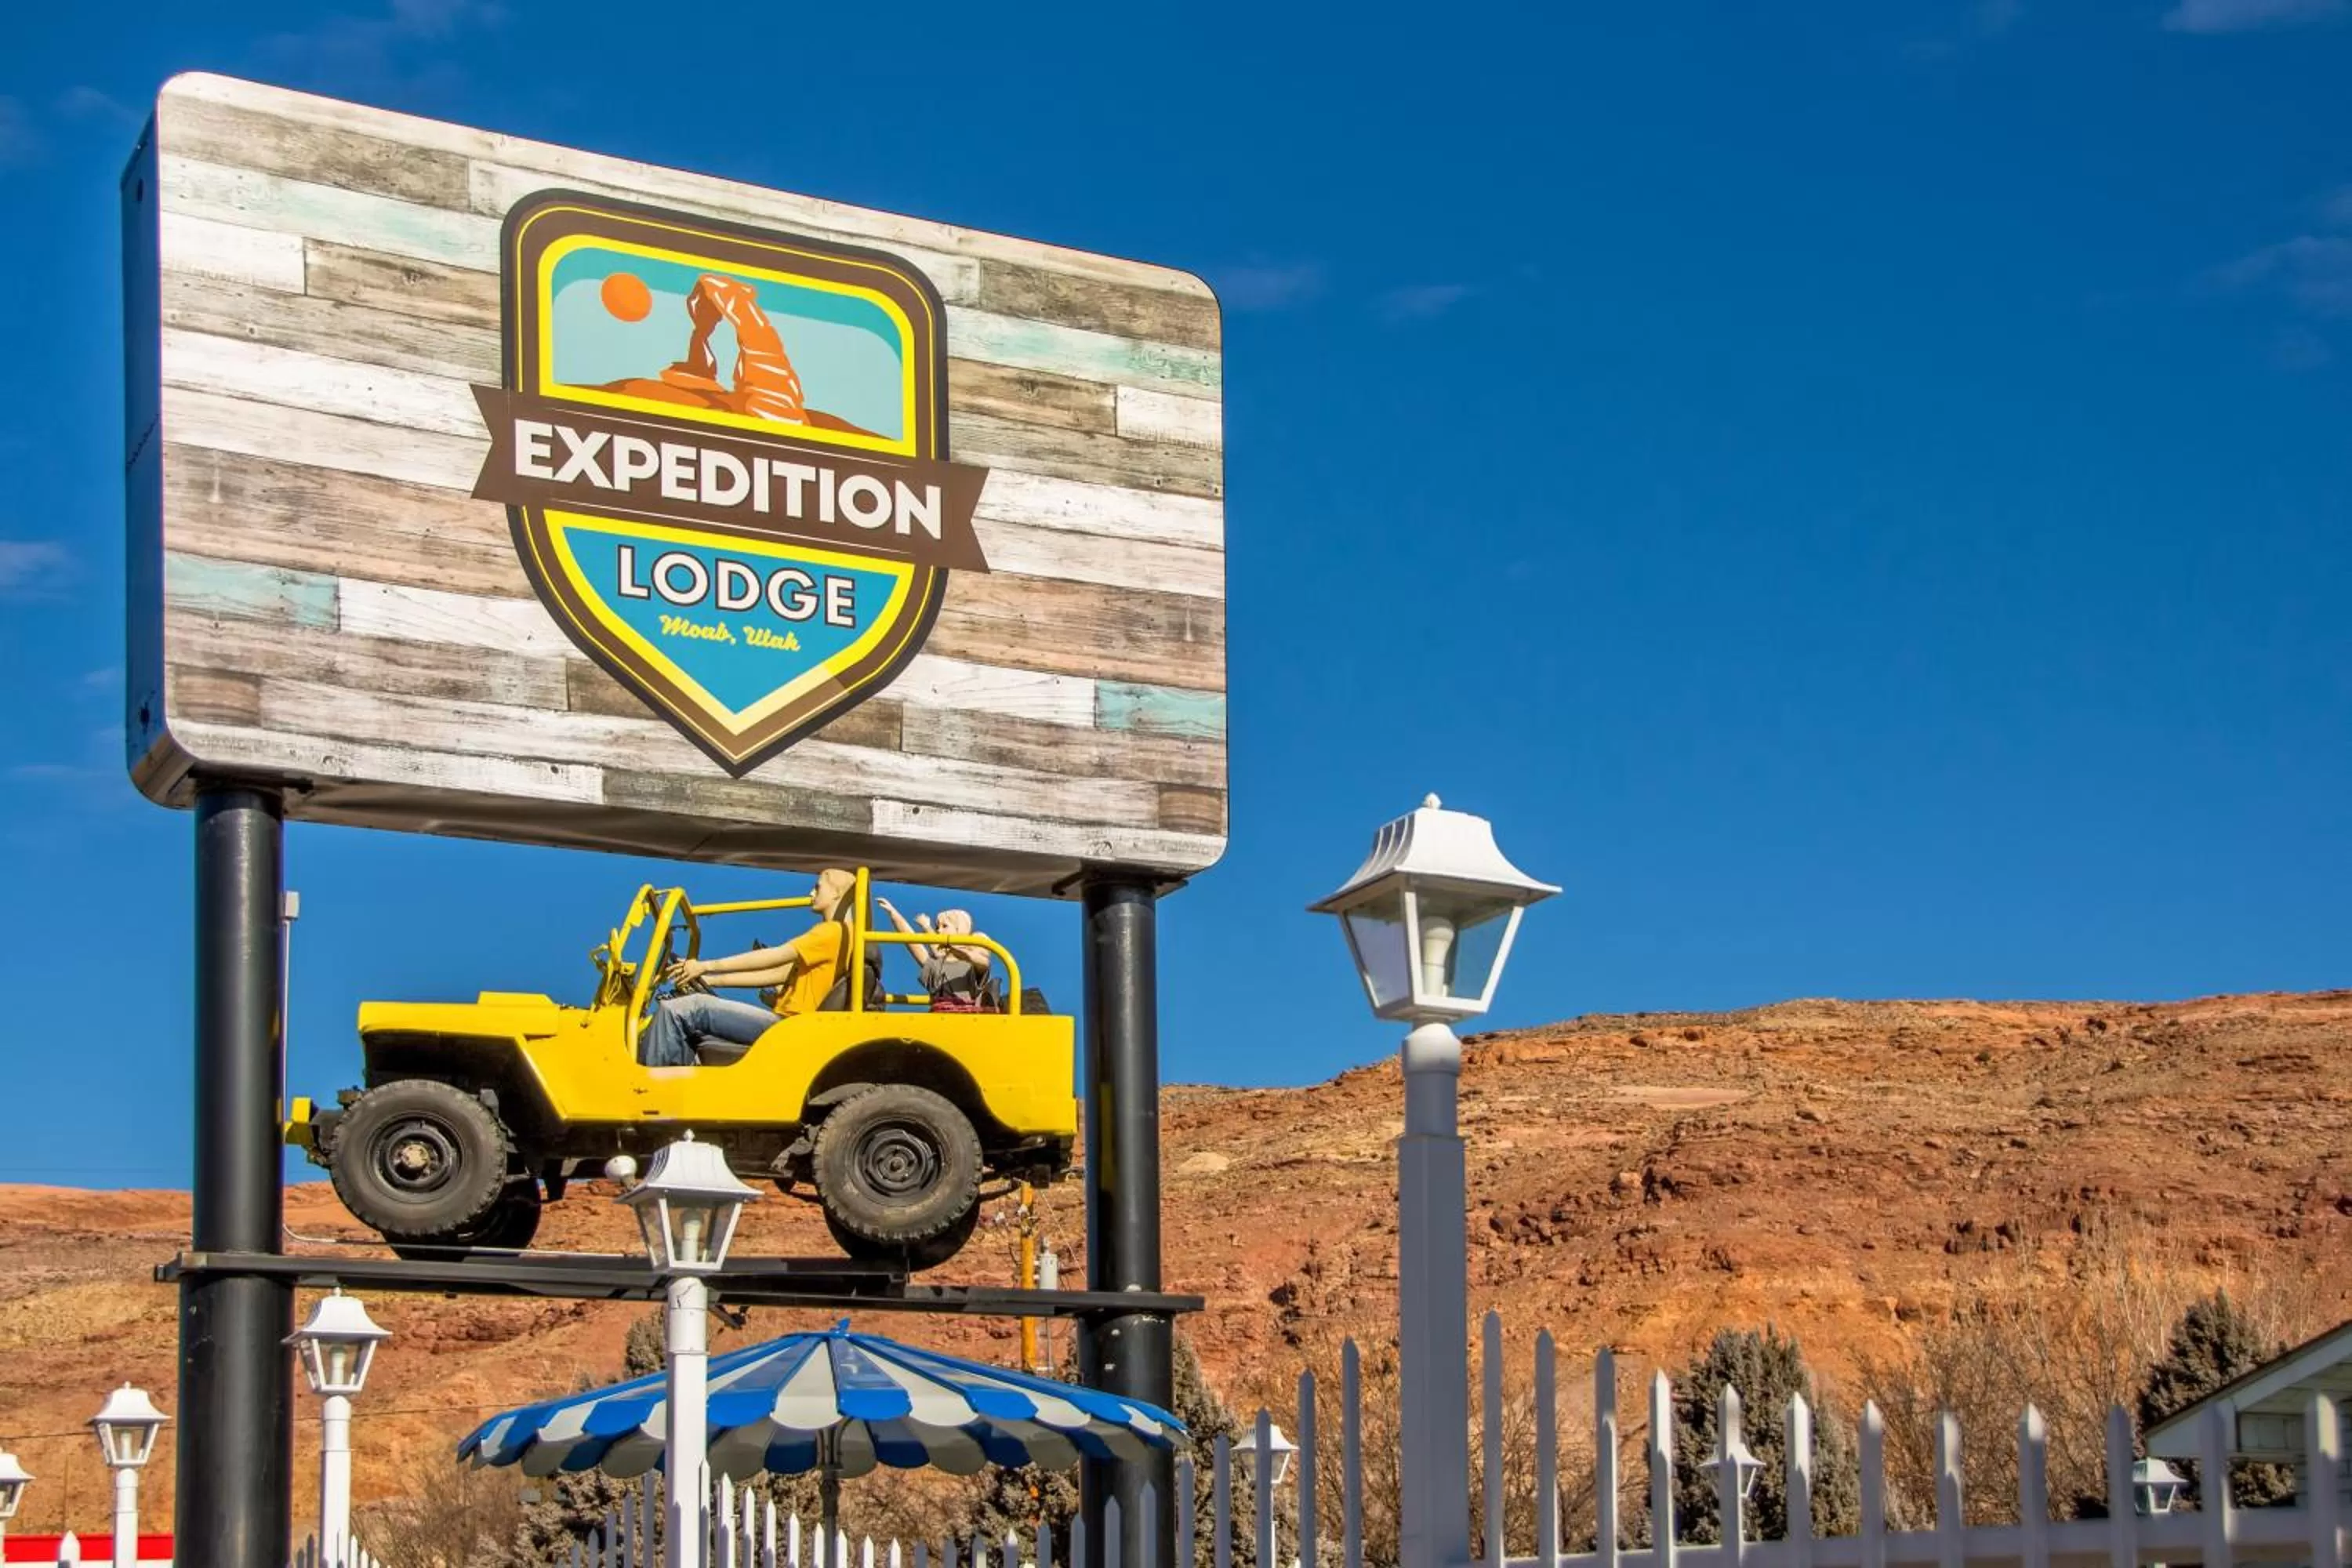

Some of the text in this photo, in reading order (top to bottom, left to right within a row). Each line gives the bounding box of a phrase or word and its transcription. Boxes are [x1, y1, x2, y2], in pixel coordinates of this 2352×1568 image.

[514, 419, 942, 539] EXPEDITION
[618, 544, 855, 628] LODGE
[659, 615, 801, 652] Moab, Utah
